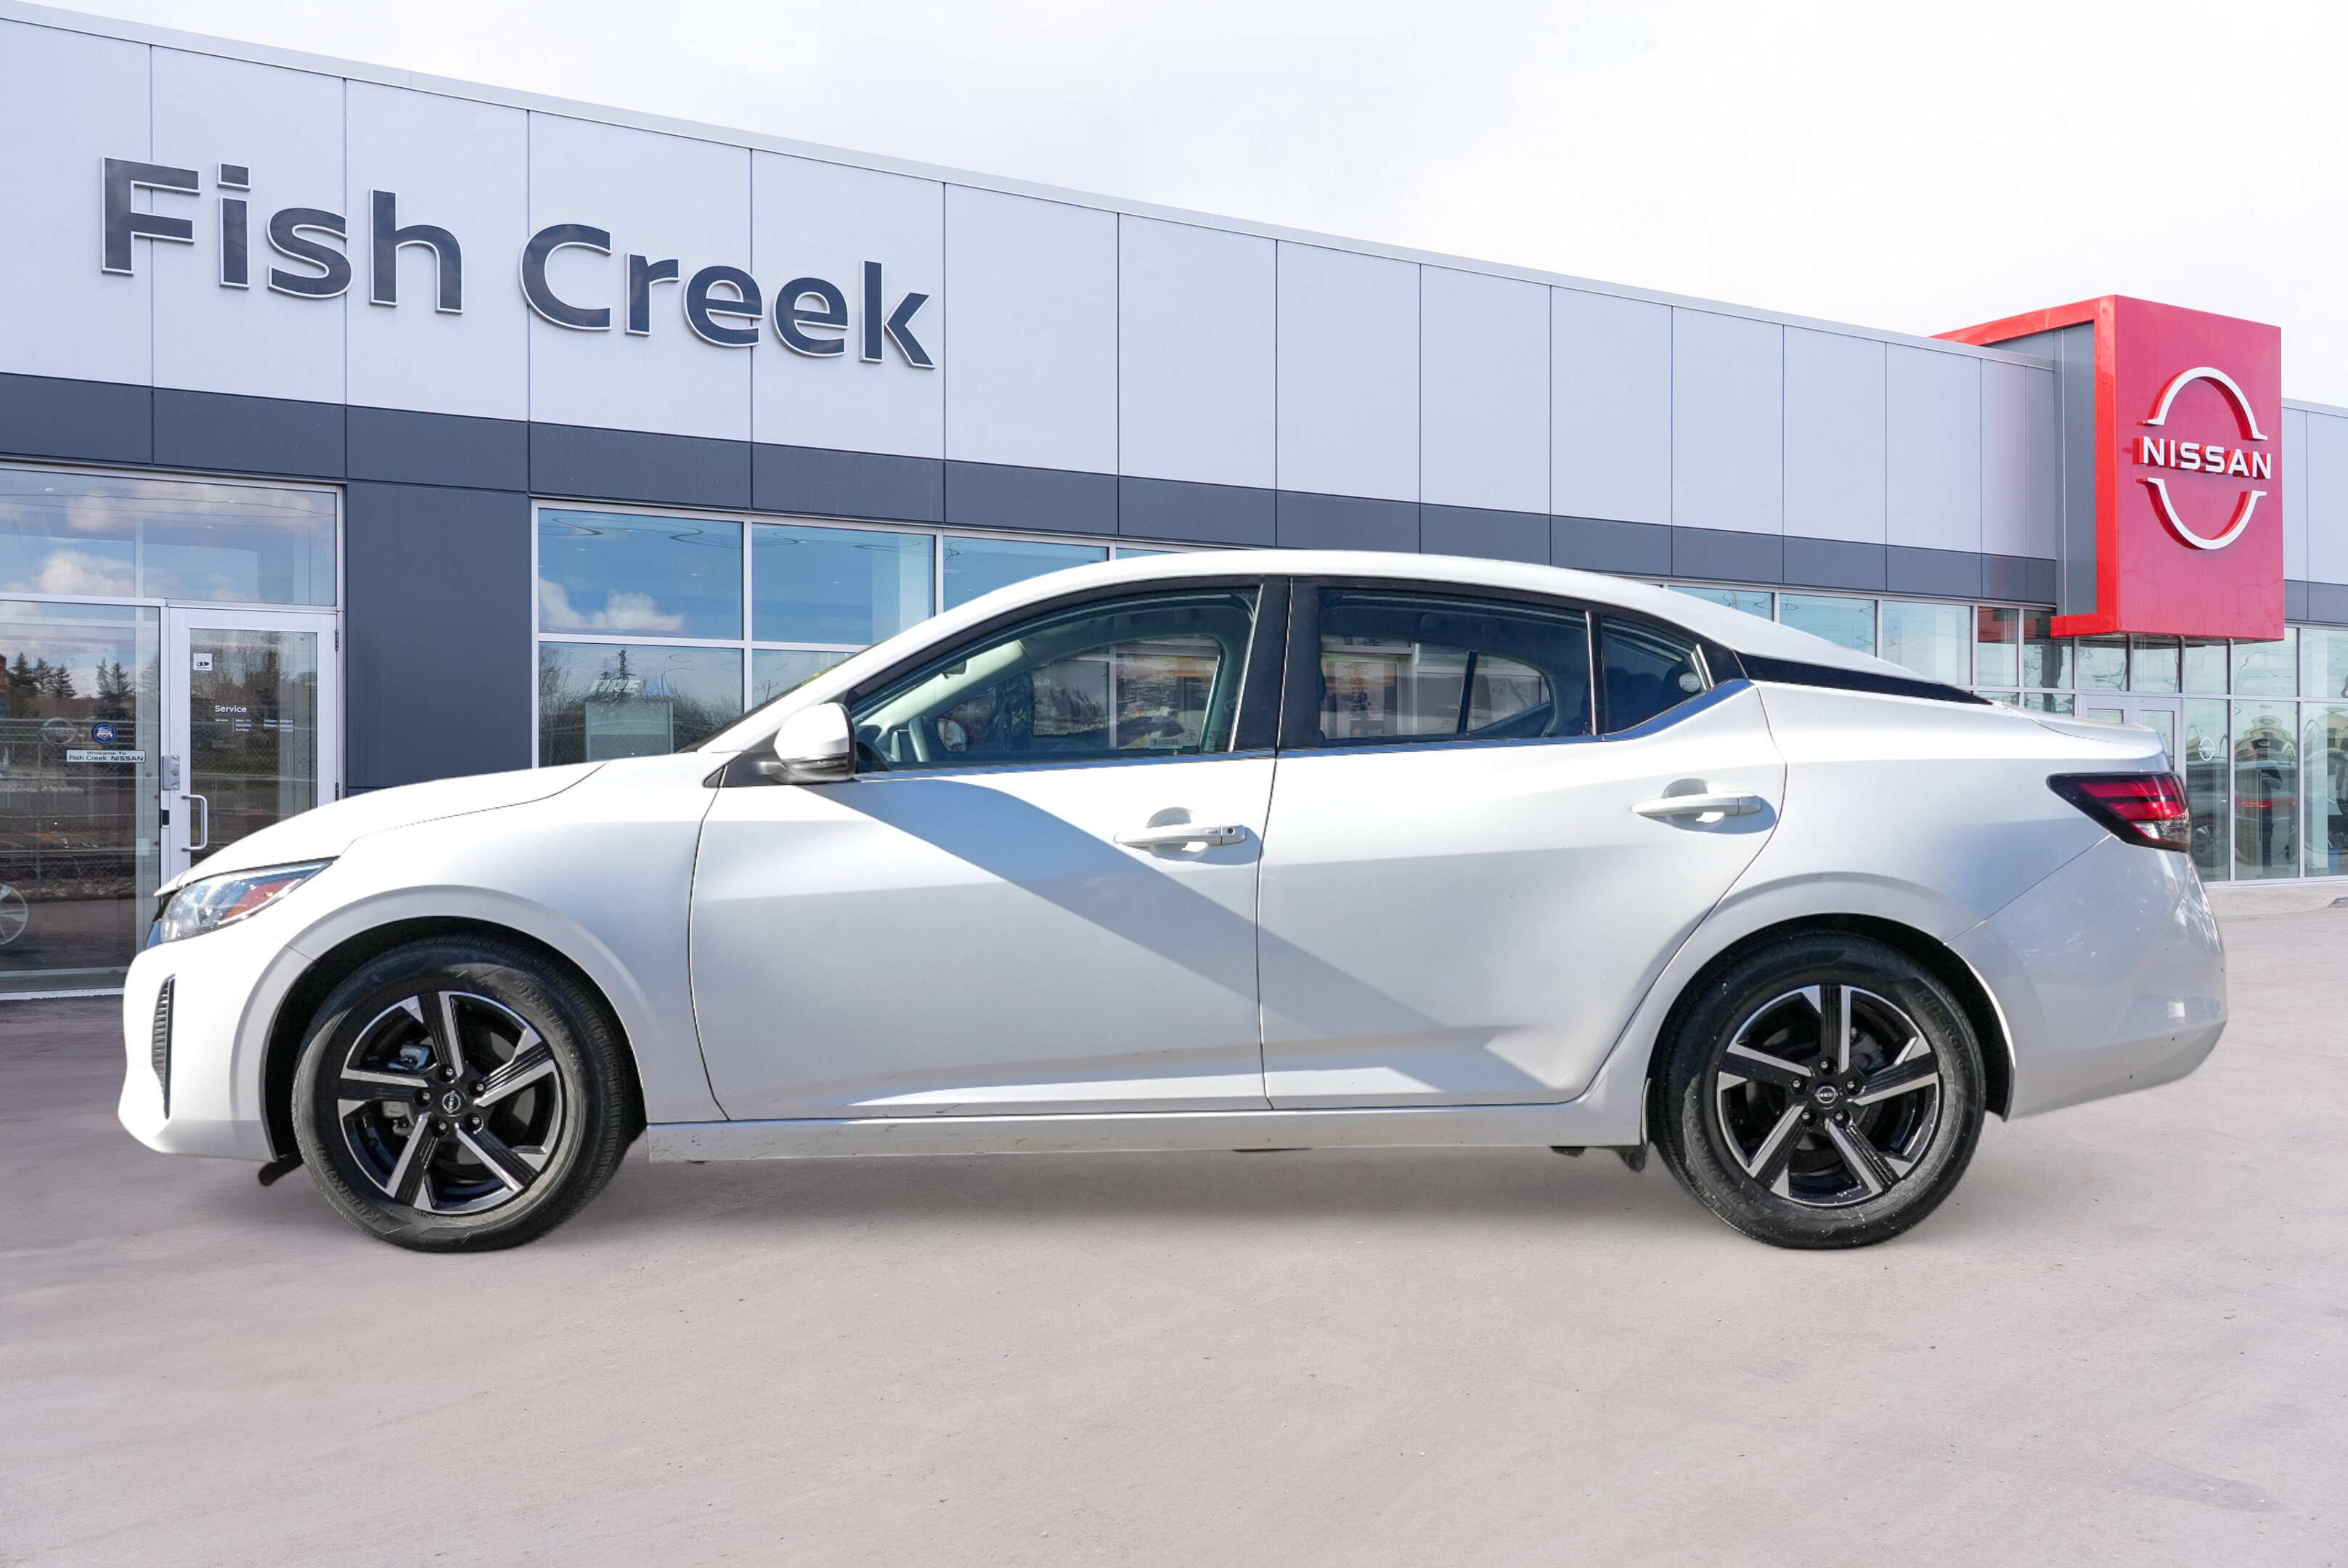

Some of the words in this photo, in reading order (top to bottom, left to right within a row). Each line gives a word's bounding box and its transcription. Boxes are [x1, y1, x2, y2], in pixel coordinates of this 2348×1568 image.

[102, 156, 463, 314] Fish
[518, 224, 937, 369] Creek
[2142, 436, 2272, 479] NISSAN
